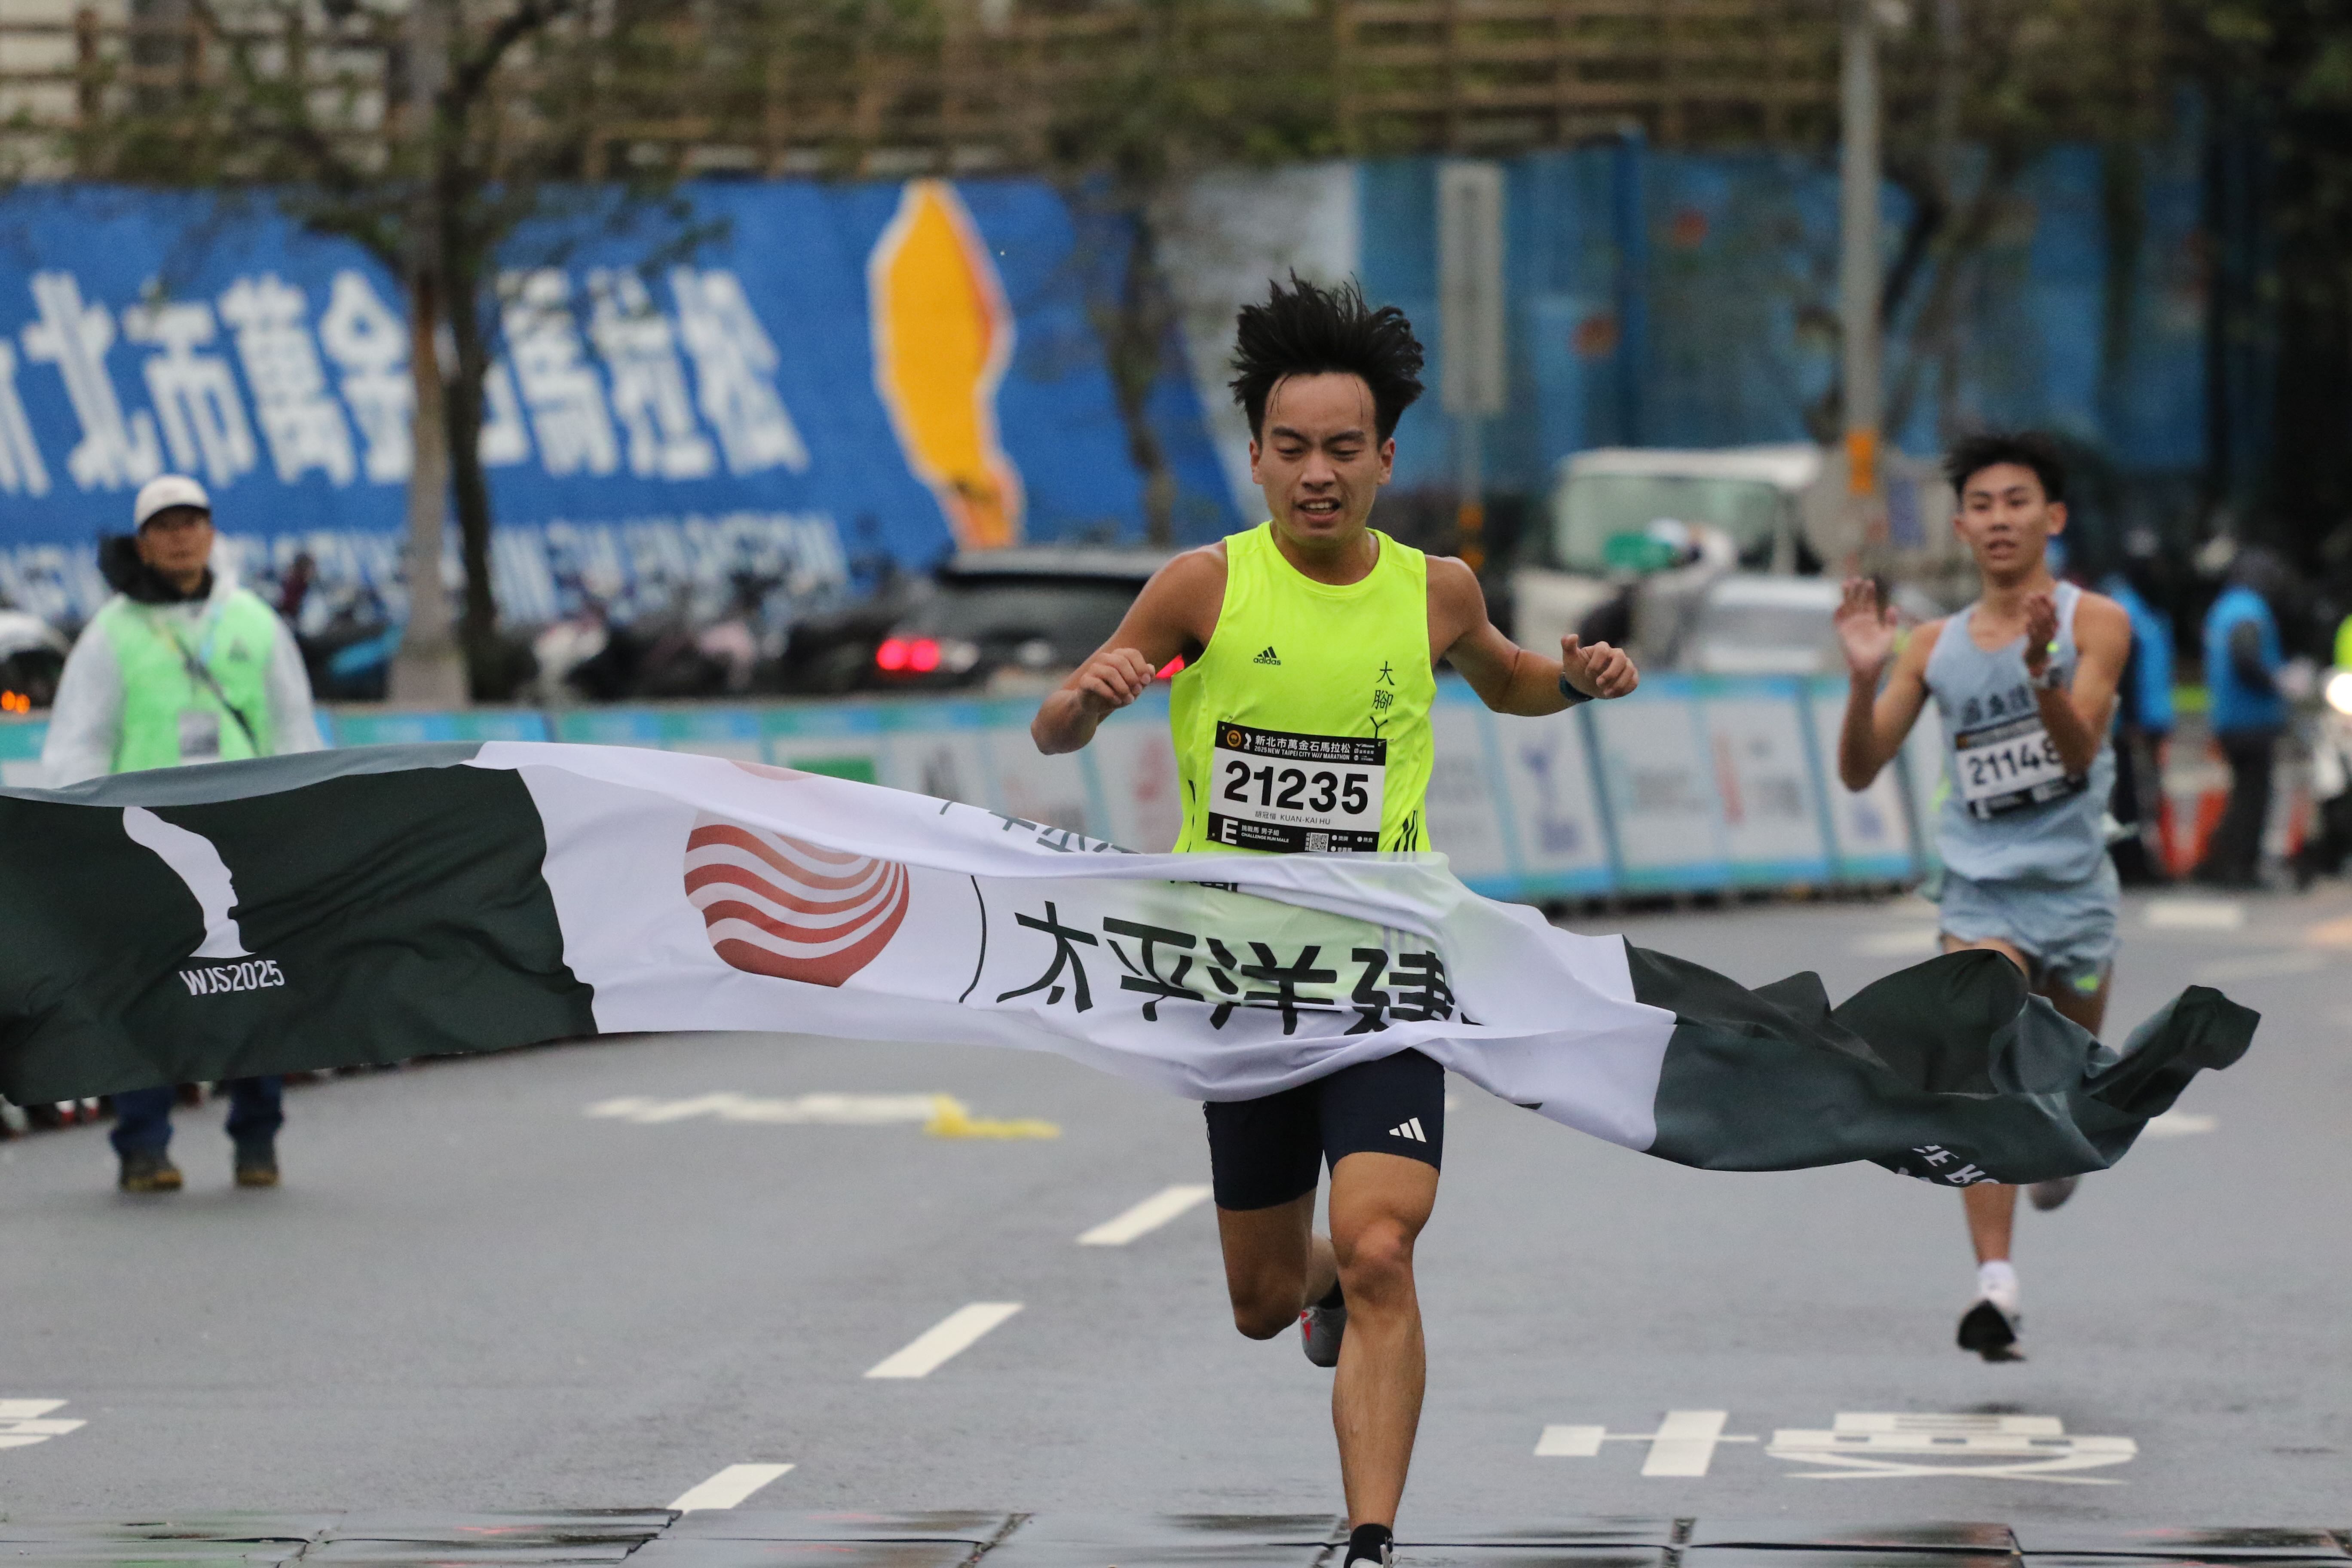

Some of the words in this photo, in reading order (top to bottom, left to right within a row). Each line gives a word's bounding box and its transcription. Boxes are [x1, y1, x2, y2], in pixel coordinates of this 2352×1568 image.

[1253, 656, 1281, 665] adidas
[1255, 735, 1351, 754] 新北市萬金石馬拉松
[1224, 760, 1369, 815] 21235
[1280, 815, 1317, 824] KUAN-KAI
[1221, 818, 1238, 845] E
[1241, 832, 1267, 840] CHALLENGE
[178, 959, 285, 996] WJS2025
